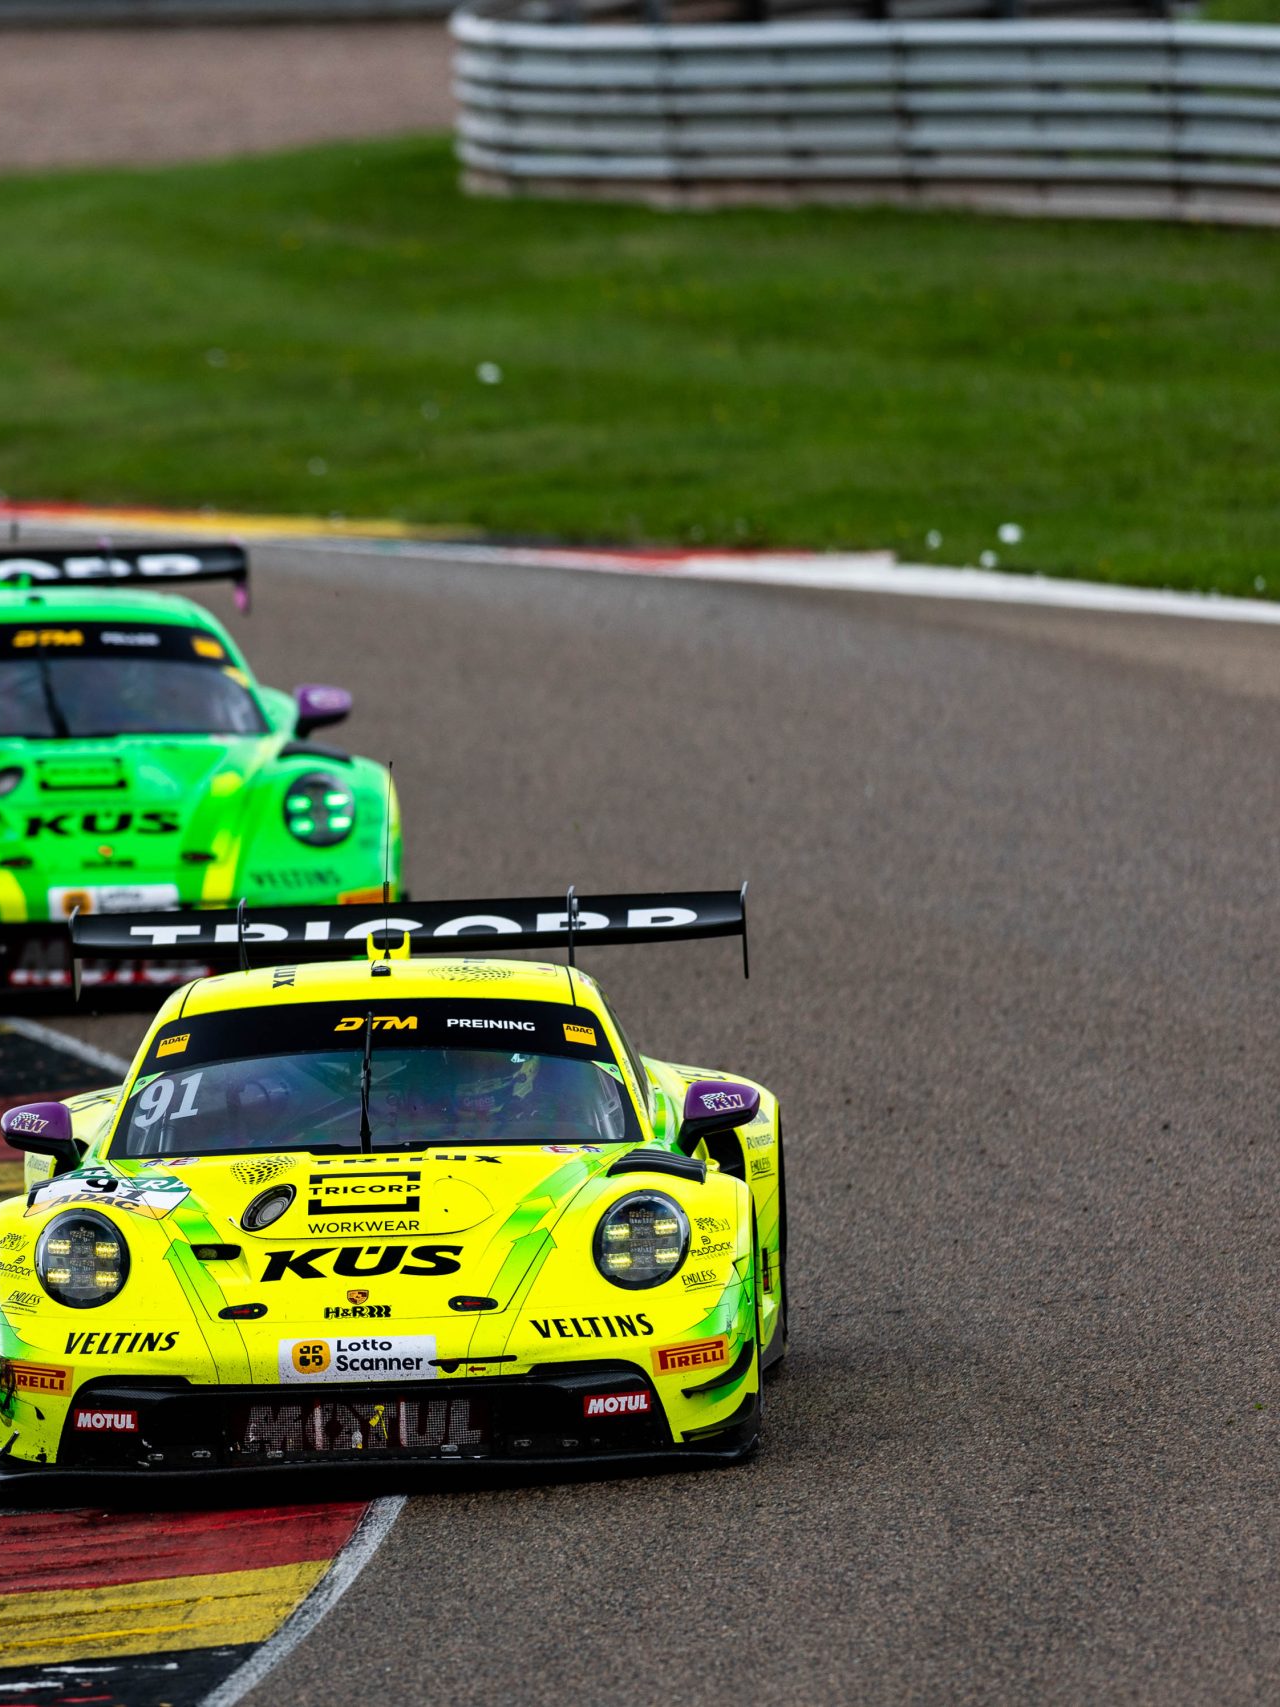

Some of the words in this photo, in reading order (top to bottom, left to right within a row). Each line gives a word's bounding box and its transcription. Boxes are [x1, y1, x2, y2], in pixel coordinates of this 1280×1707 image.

[333, 1015, 419, 1032] DTM
[446, 1018, 536, 1032] PREINING
[565, 1024, 593, 1036] ADAC
[160, 1033, 189, 1047] ADAC
[134, 1072, 204, 1129] 91
[308, 1184, 421, 1196] TRICORP
[307, 1220, 420, 1234] WORKWEAR
[260, 1244, 465, 1283] KÜS
[681, 1269, 717, 1286] ENDLESS
[7, 1290, 43, 1306] ENDLESS
[529, 1312, 655, 1339] VELTINS
[63, 1331, 181, 1355] VELTINS
[336, 1338, 393, 1352] Lotto
[336, 1354, 424, 1372] Scanner
[657, 1339, 725, 1371] PIRELLI
[587, 1394, 649, 1415] MOTUL
[76, 1412, 136, 1430] MOTUL
